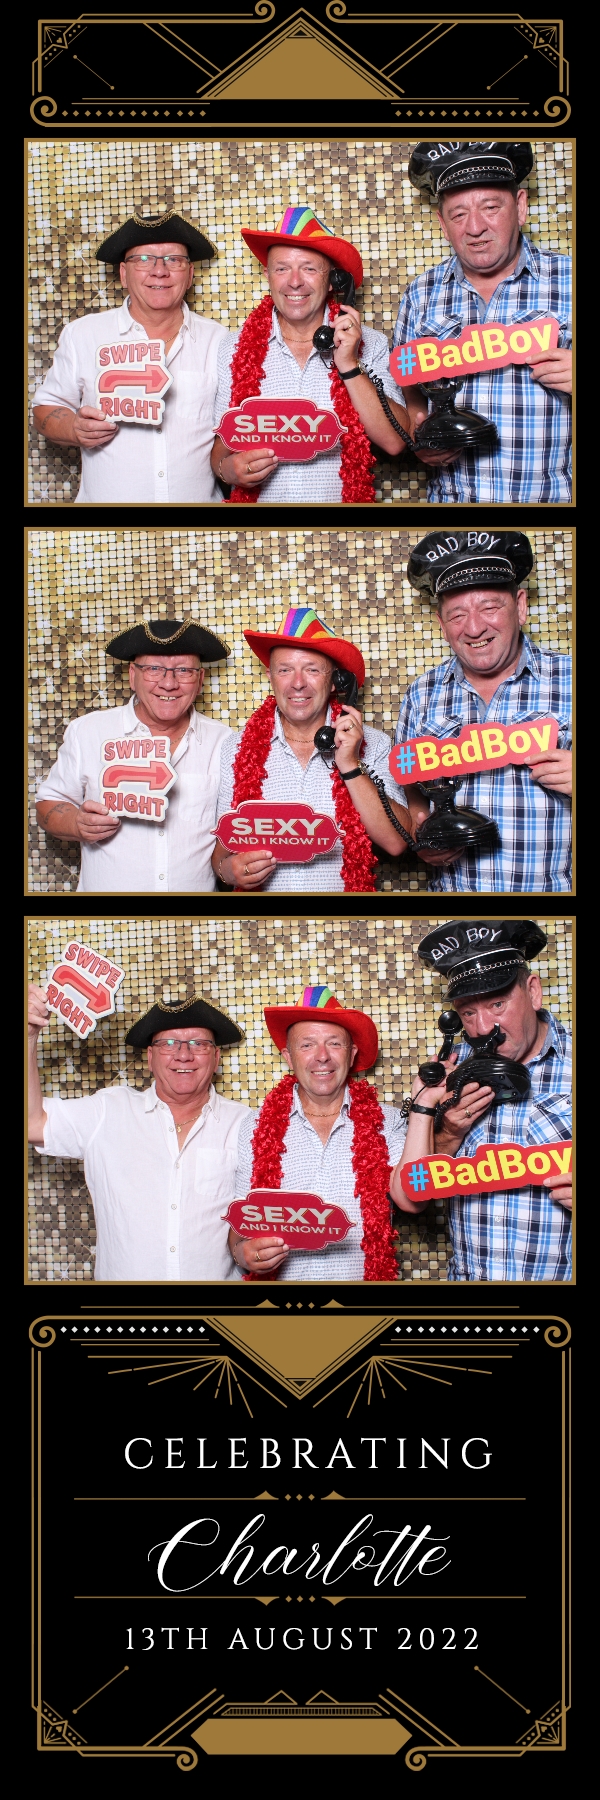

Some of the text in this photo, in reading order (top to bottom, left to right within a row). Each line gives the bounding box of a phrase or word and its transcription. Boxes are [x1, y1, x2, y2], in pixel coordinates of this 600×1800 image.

[99, 343, 161, 366] SWIPE
[397, 324, 551, 376] #BadBoy
[99, 397, 160, 420] RIGHT
[234, 414, 327, 433] SEXY
[230, 434, 331, 443] AND I KNOW IT
[426, 531, 501, 561] BAD BOY
[104, 739, 166, 761] SWIPE
[396, 724, 551, 775] #BadBoy
[103, 792, 164, 817] RIGHT
[231, 818, 324, 836] SEXY
[228, 836, 330, 846] AND I KNOW IT
[431, 927, 502, 961] BAD BOY
[65, 943, 122, 989] SWIPE
[47, 983, 94, 1035] RIGHT
[408, 1147, 572, 1192] #BadBoy
[240, 1205, 335, 1225] SEXY
[240, 1222, 342, 1235] AND I KNOW IT
